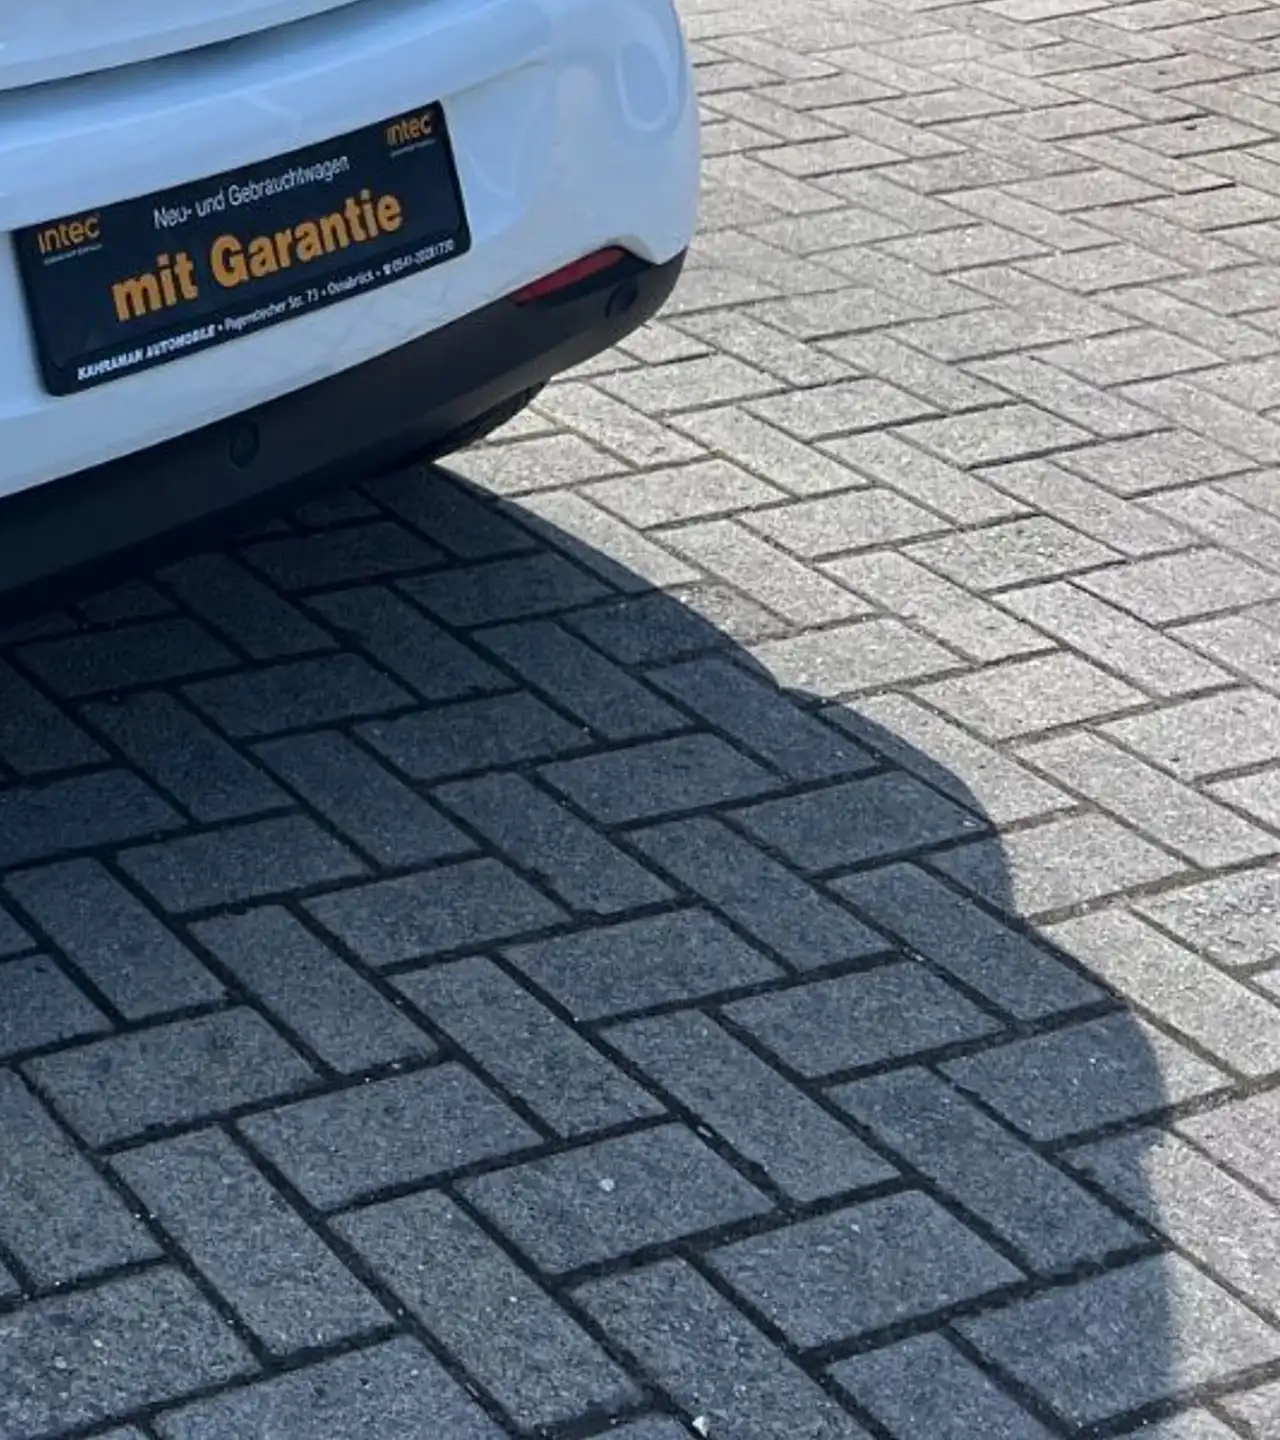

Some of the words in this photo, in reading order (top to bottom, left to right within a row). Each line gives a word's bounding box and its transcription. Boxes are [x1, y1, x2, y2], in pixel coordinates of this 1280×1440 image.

[154, 205, 192, 230] Neu-
[196, 190, 225, 221] und
[228, 155, 350, 207] Gebrauchtwagen
[112, 251, 198, 322] mit
[210, 190, 403, 289] Garantie
[77, 347, 144, 381] KAHRAMAN
[145, 323, 217, 359] AUTOMOBILE
